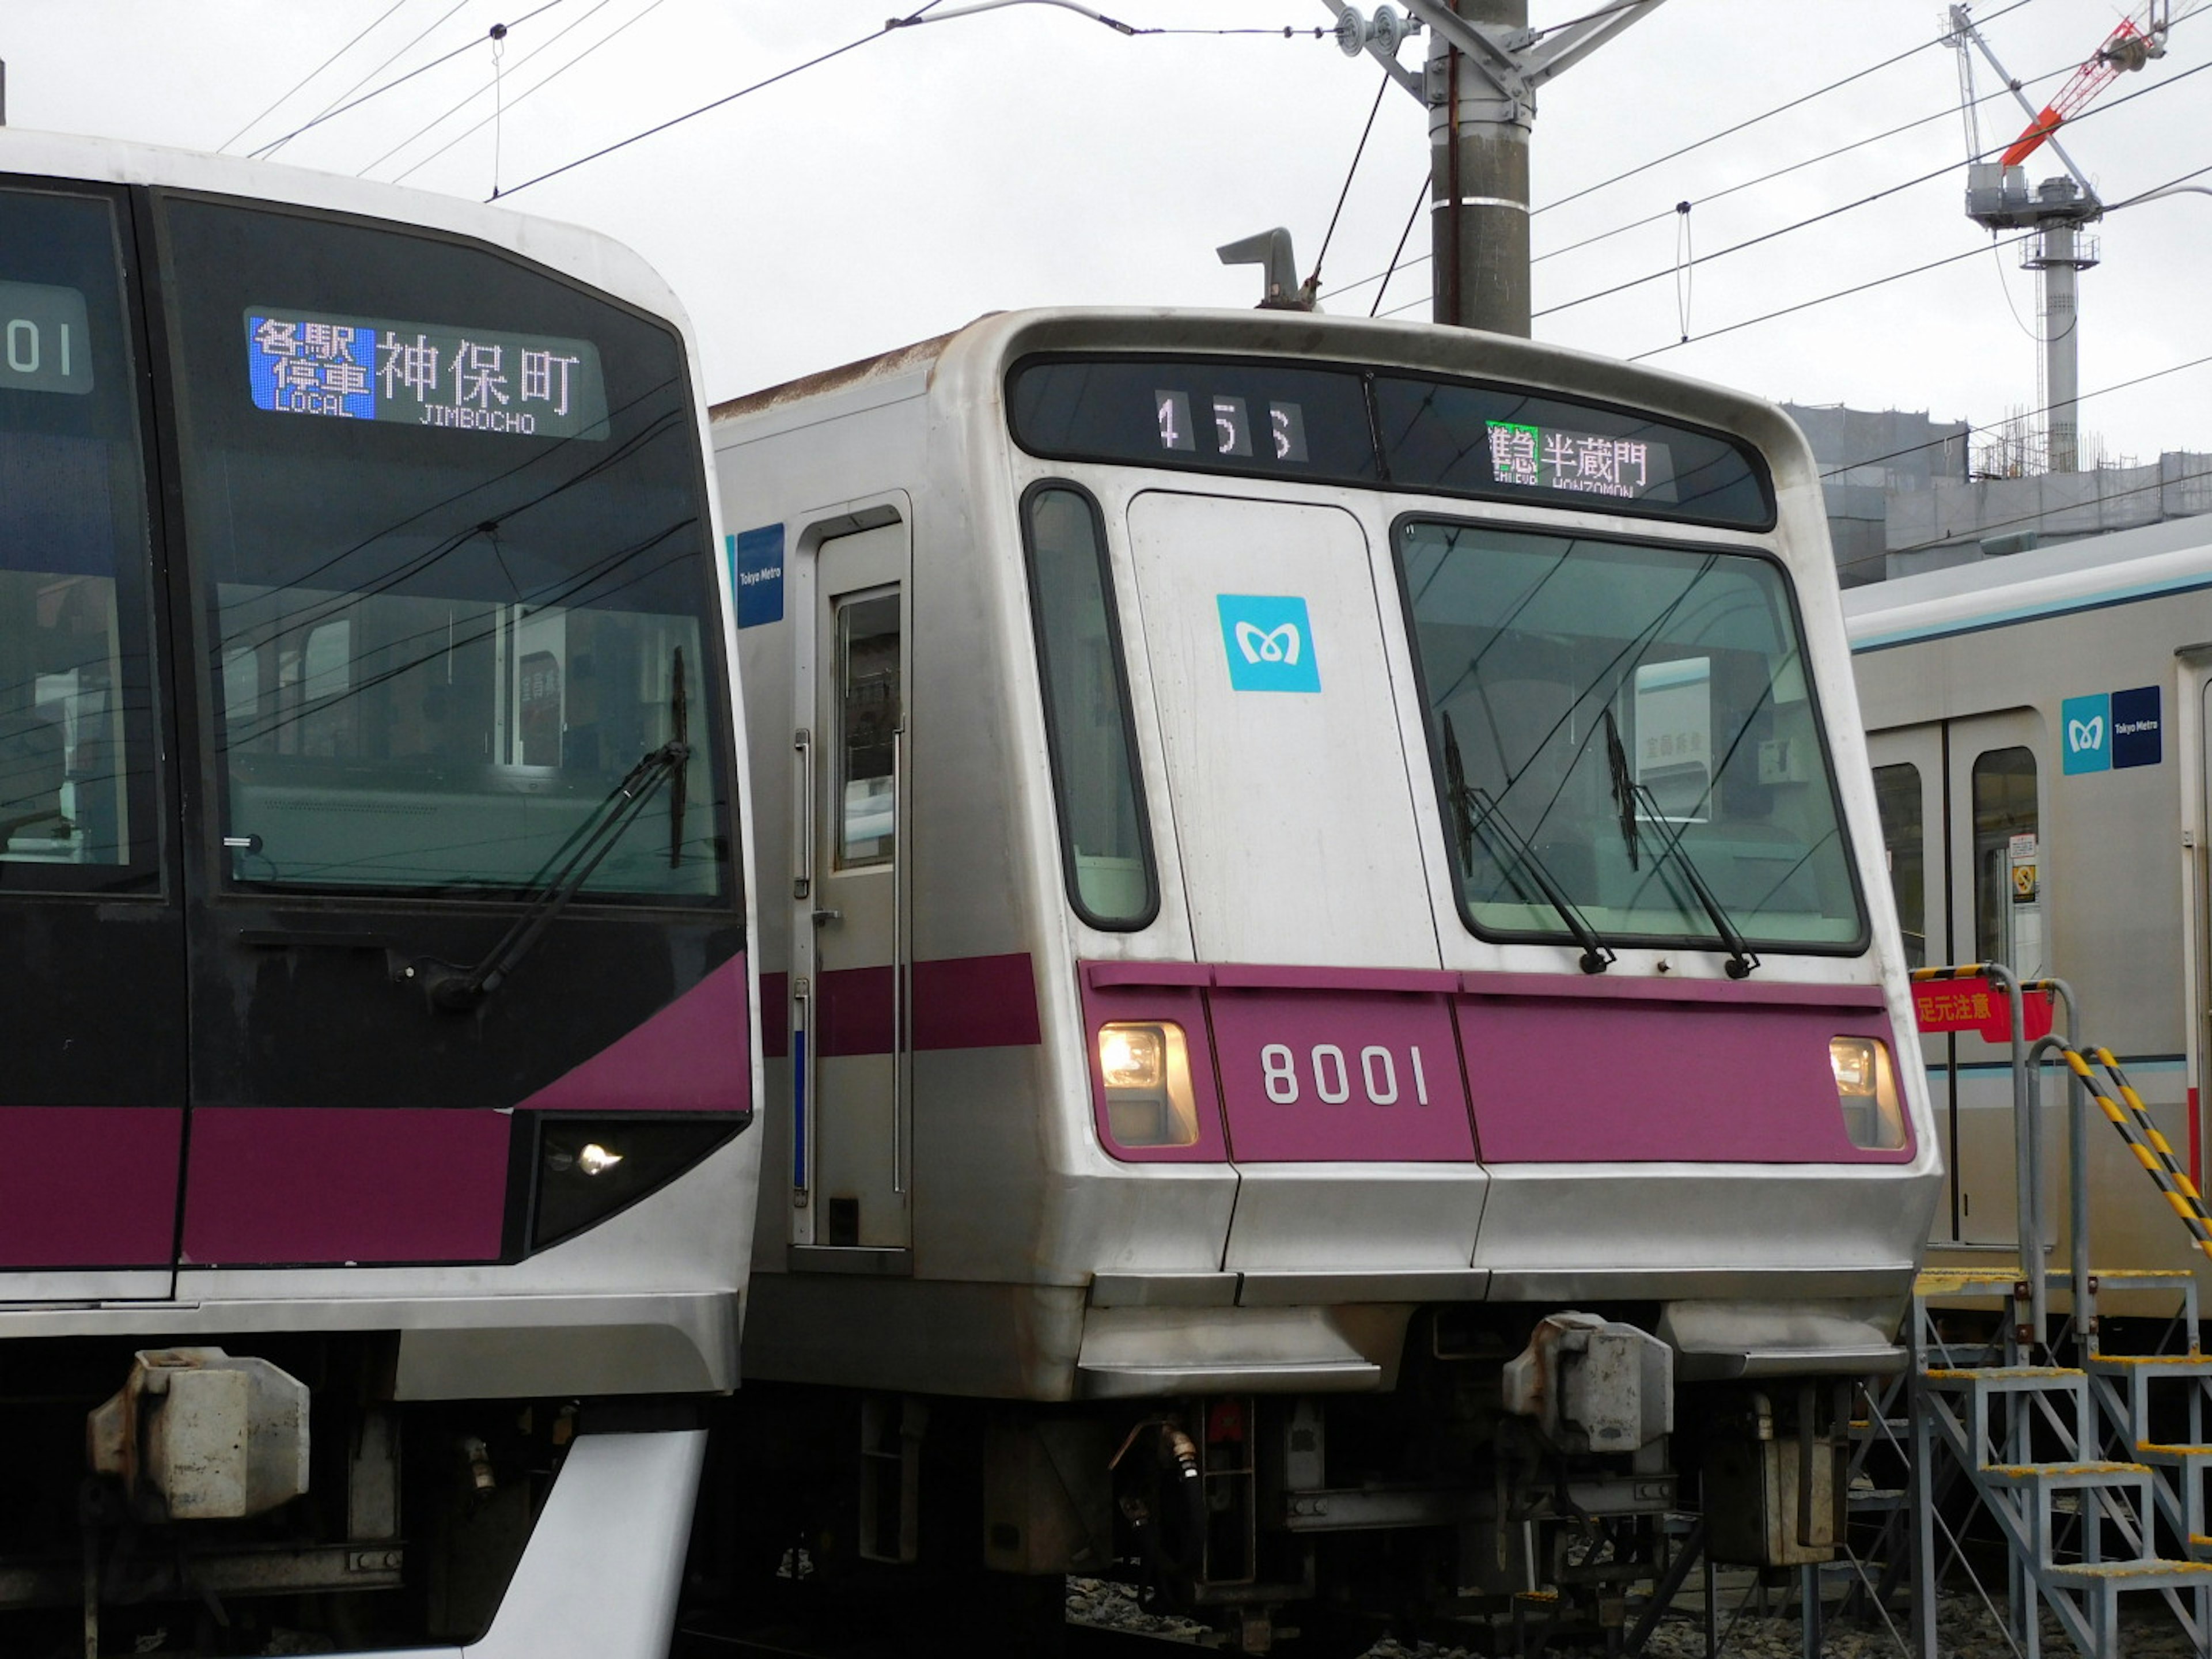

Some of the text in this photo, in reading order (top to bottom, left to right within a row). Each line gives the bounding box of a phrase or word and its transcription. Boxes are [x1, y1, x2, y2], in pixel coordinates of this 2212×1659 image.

[255, 319, 355, 361] 各駅
[271, 358, 370, 394] 停車
[376, 331, 579, 416] 神保町
[275, 388, 353, 418] LOCAL
[420, 404, 535, 434] JIMBOCHO
[1541, 433, 1647, 487] 半蔵門
[1552, 477, 1634, 499] HONZOMON
[740, 567, 781, 586] Tokyo Metro
[2115, 720, 2158, 735] Tokyo Metro
[1918, 993, 1991, 1022] 足元注意
[1261, 1044, 1428, 1105] 8001
